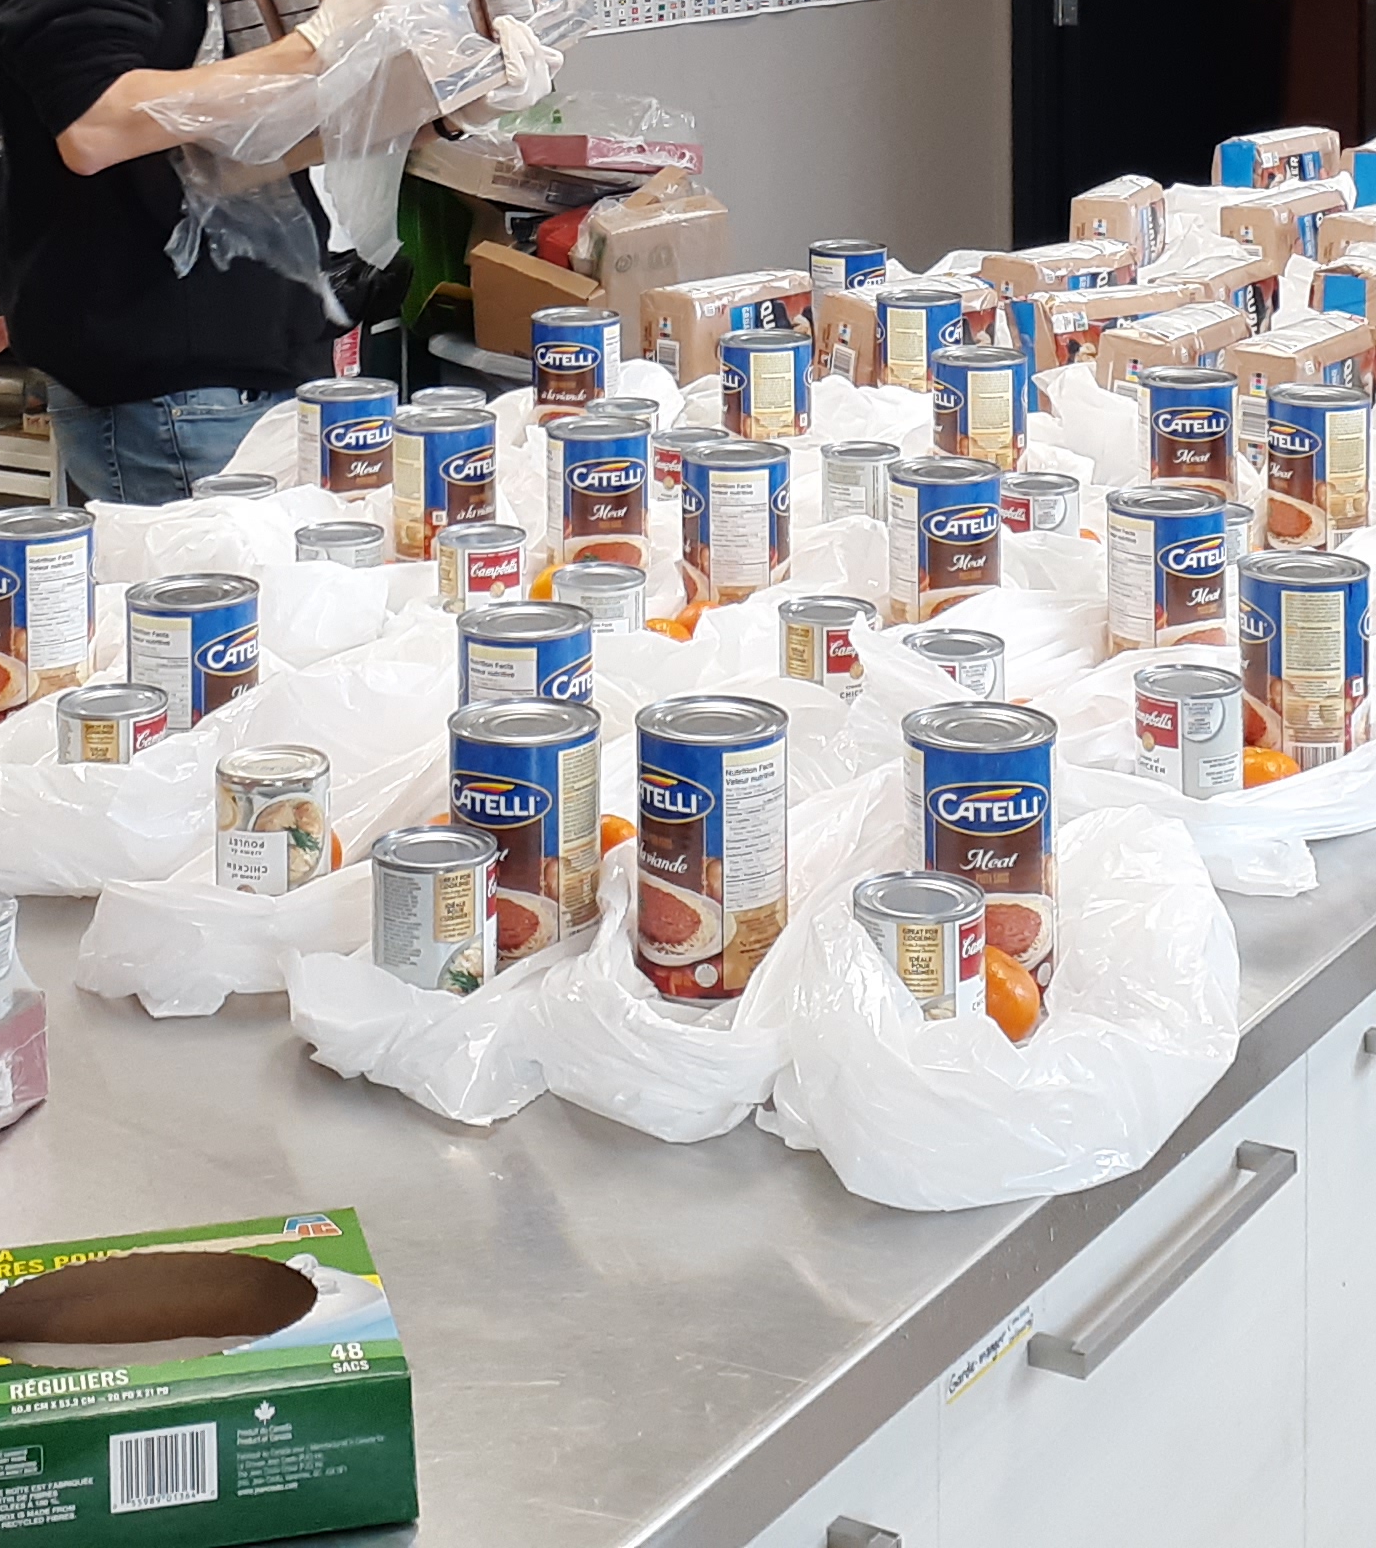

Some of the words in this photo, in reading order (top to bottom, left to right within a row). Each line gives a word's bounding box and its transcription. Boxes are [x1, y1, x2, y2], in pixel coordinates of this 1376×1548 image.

[536, 347, 592, 367] CATELLI
[1158, 413, 1225, 434] CATELLI
[1172, 448, 1211, 464] Meat
[345, 460, 384, 479] Meat
[572, 468, 641, 488] CATELLI
[588, 504, 627, 521] Meat
[930, 515, 998, 537] CATELLI
[947, 554, 987, 572] Meat
[1186, 586, 1222, 606] Meat
[450, 778, 537, 818] CATELLI
[937, 792, 1040, 823] CATELLI
[229, 837, 266, 849] POULET
[226, 862, 269, 874] CHICKEN
[960, 848, 1020, 871] Meat
[330, 1342, 364, 1361] 48
[332, 1359, 370, 1374] SACS
[9, 1369, 130, 1400] RÉGULIERS
[26, 1508, 50, 1519] MADE
[51, 1504, 76, 1517] FROM
[1, 1517, 44, 1531] RECYCLED
